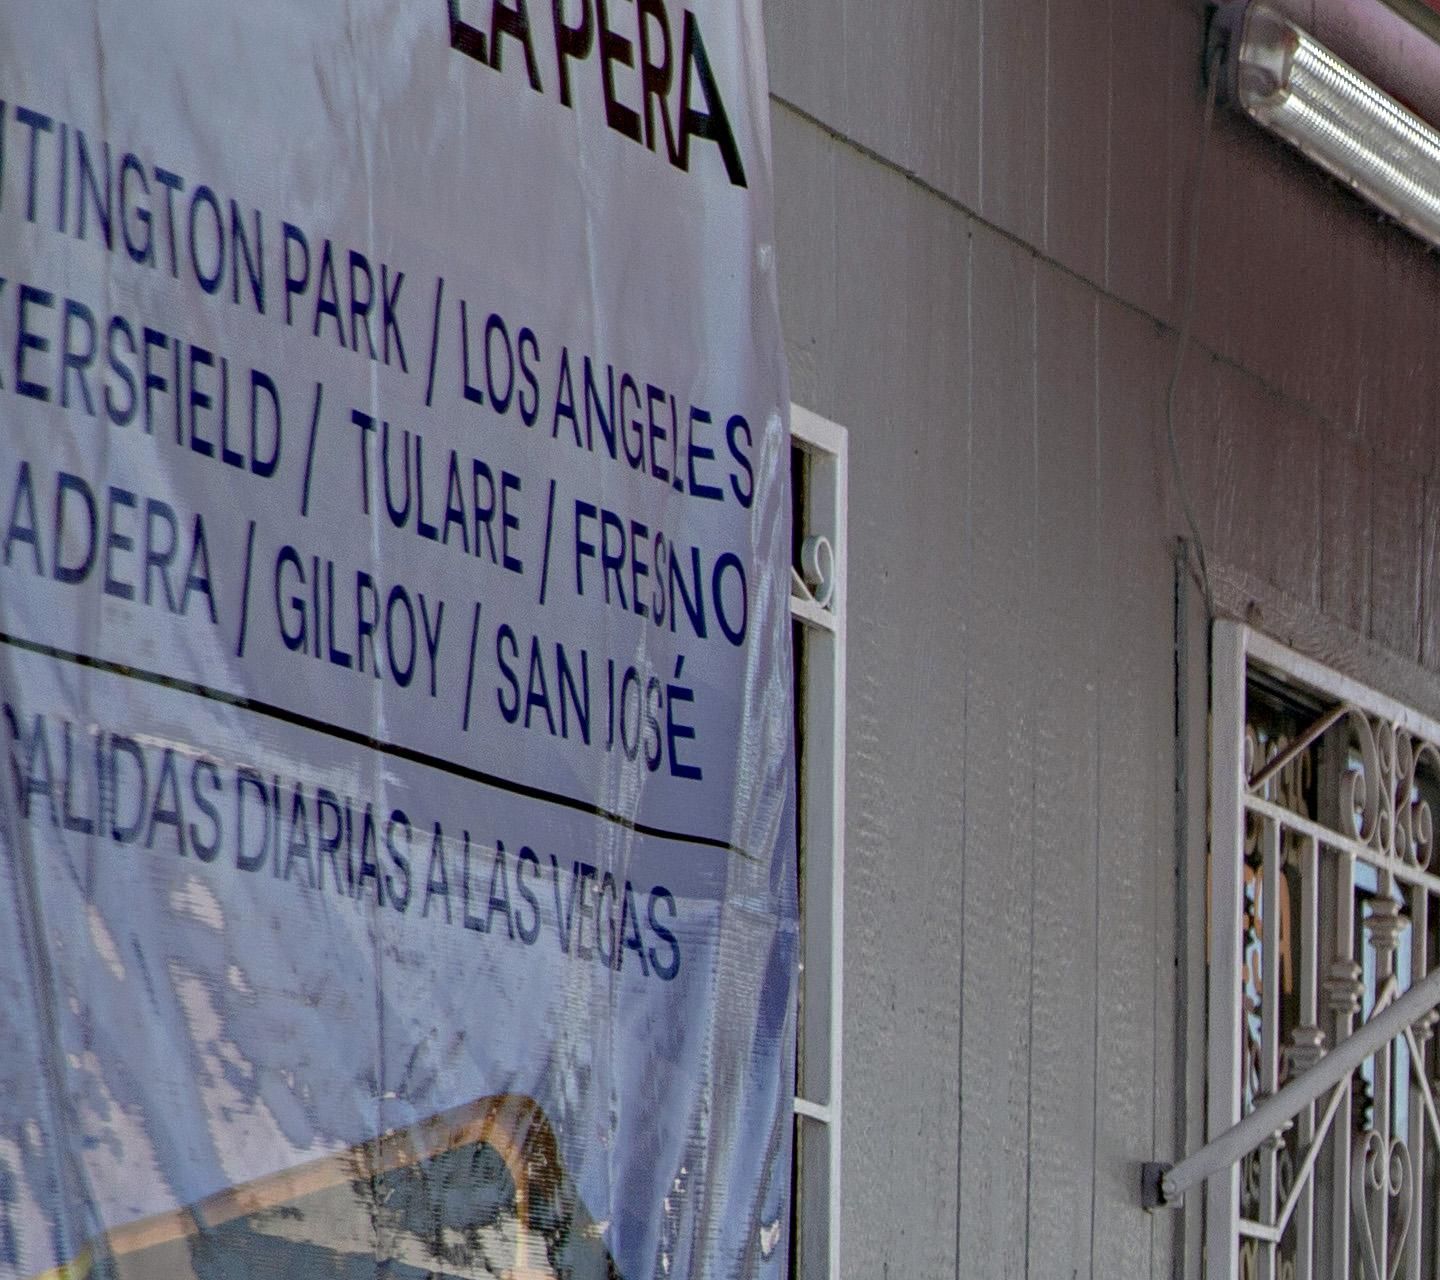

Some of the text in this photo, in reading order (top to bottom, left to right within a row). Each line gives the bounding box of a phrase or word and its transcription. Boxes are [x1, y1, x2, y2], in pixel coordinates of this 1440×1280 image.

[553, 0, 747, 188] PERA
[0, 98, 755, 509] TINGTON PARK / LOS ANGELES
[0, 276, 749, 647] ERSFIELD / TULARE / FRESNO
[2, 460, 704, 781] ADERA / GILROY / SAN JOSÉ
[236, 765, 414, 915] DIARIAS
[423, 820, 452, 922] A
[462, 838, 542, 946] LAS
[550, 851, 681, 982] VEGAS
